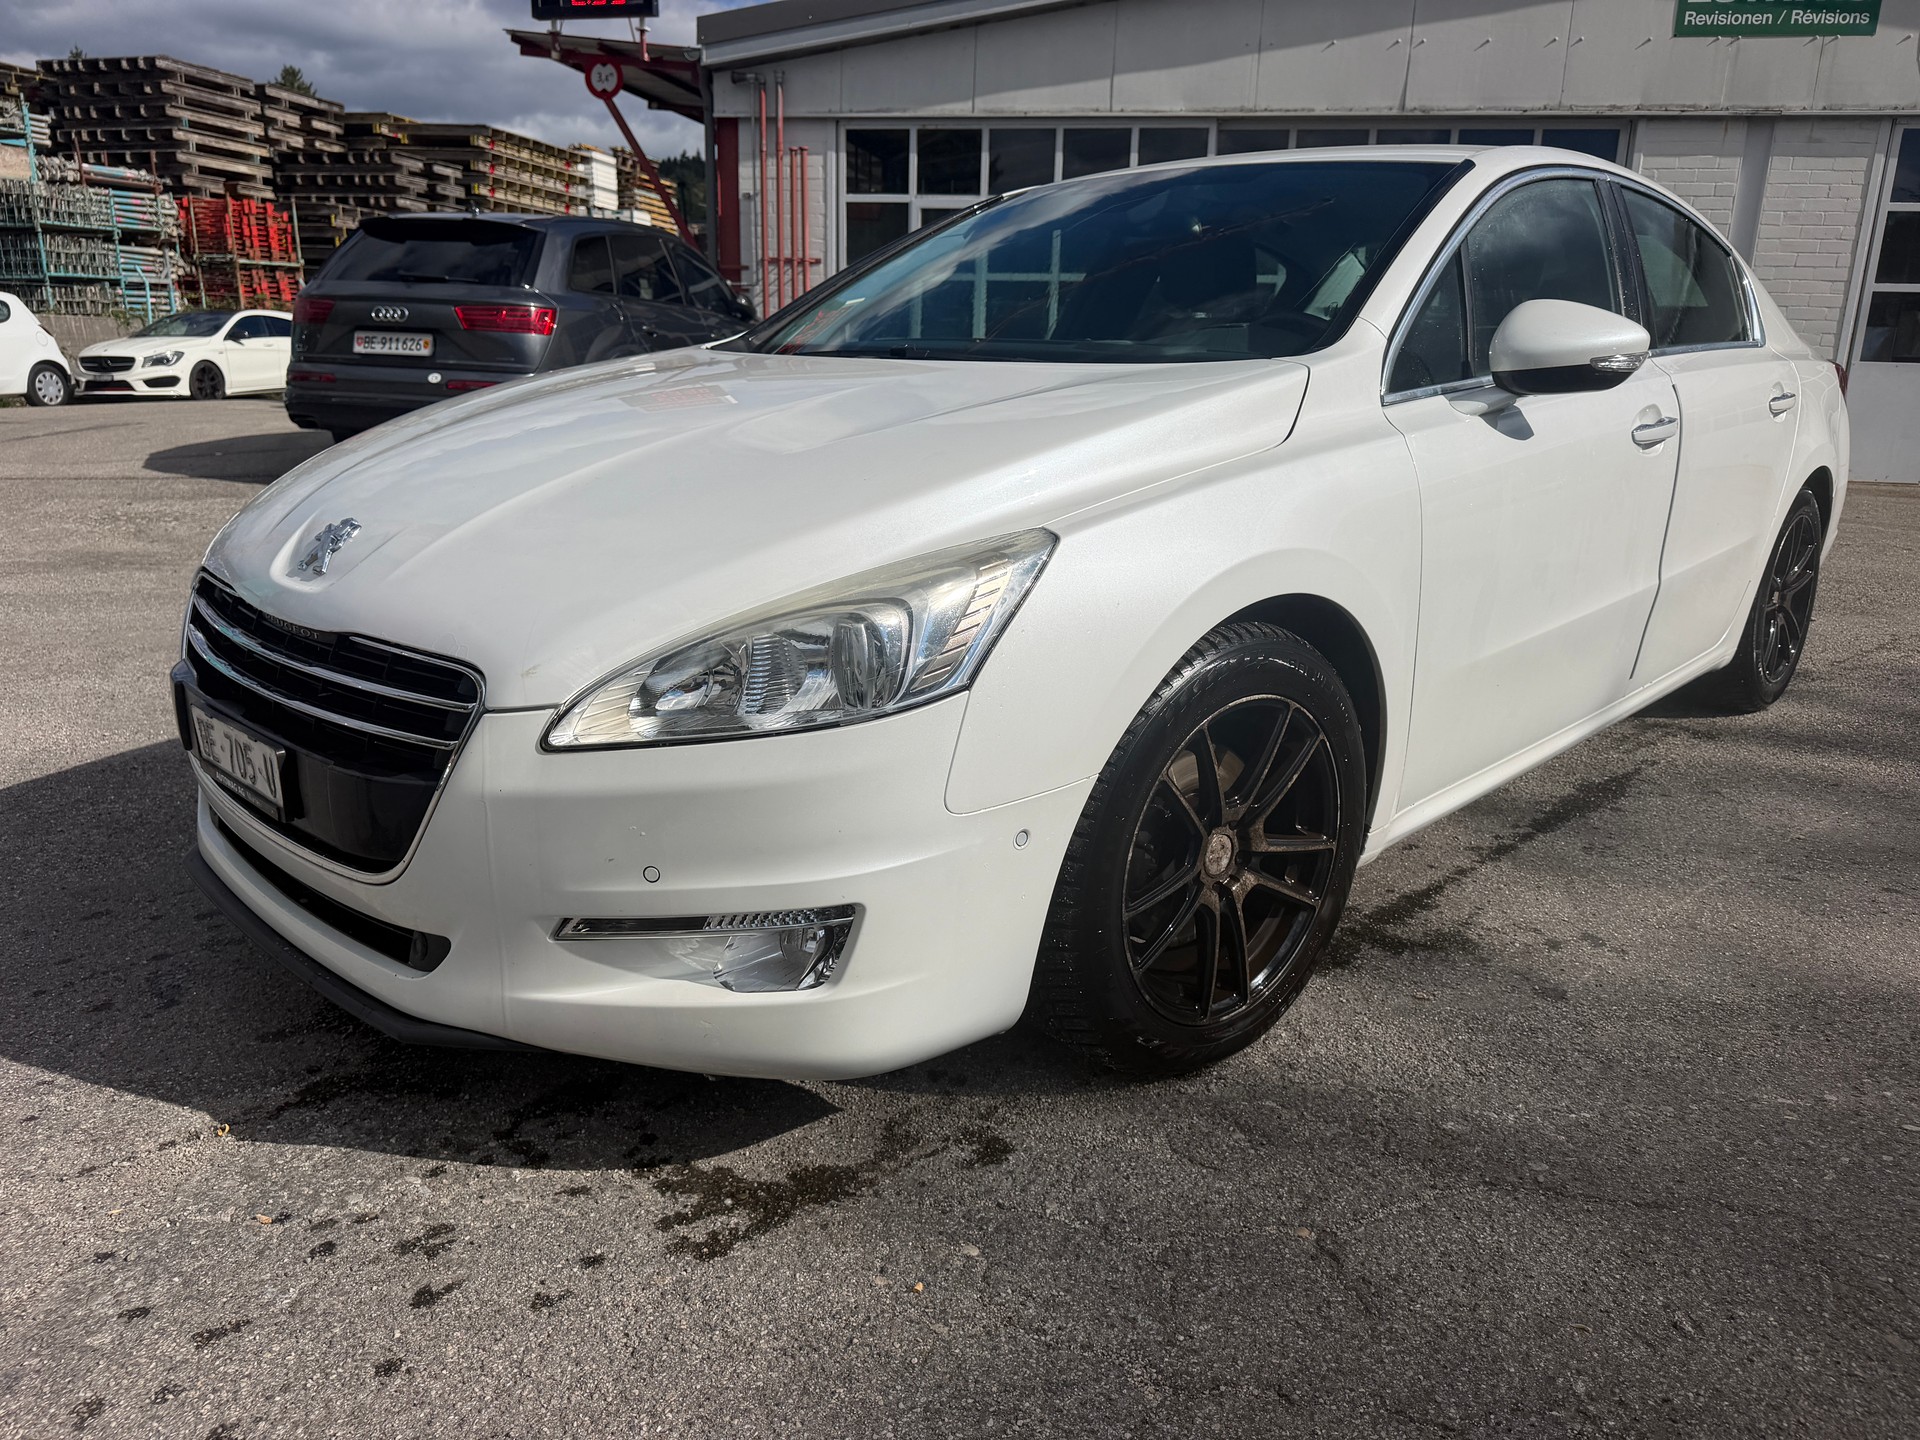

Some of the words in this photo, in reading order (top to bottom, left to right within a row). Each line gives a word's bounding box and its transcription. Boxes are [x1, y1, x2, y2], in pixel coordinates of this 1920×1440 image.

[1684, 11, 1773, 25] Revisionen
[1777, 10, 1786, 24] /
[1791, 9, 1870, 24] Révisions
